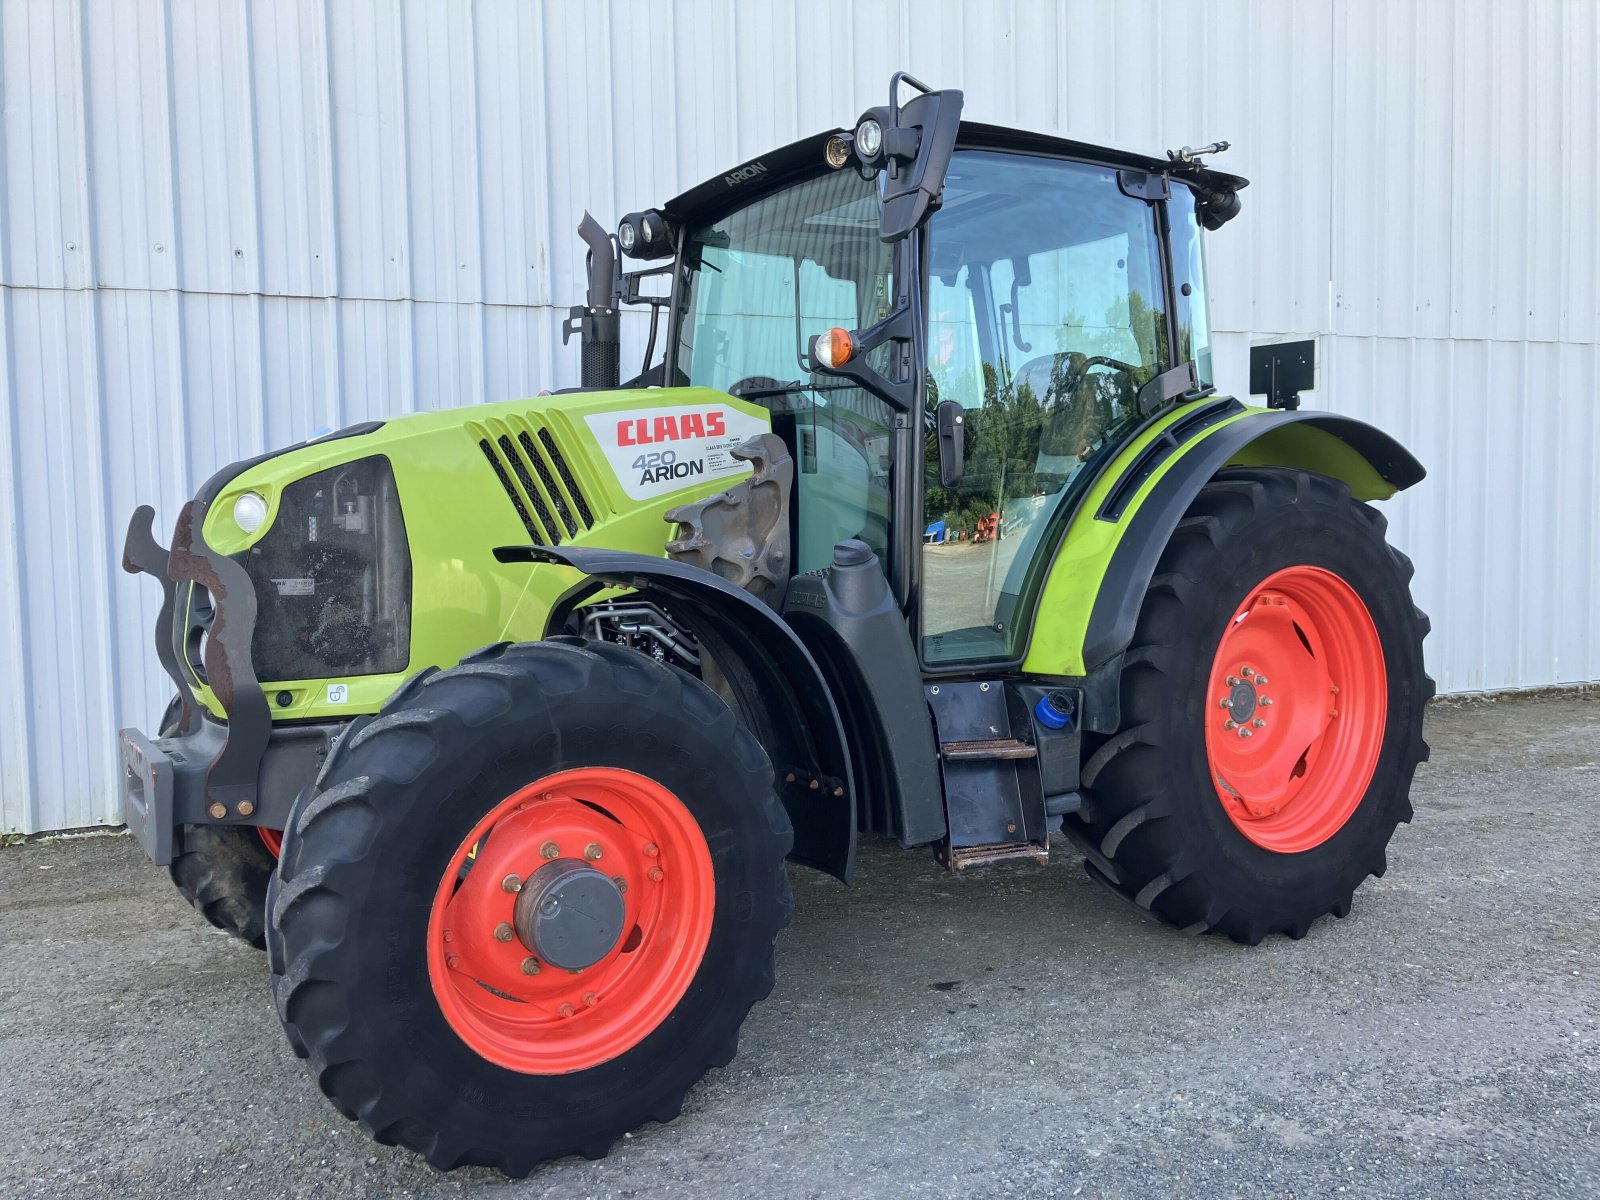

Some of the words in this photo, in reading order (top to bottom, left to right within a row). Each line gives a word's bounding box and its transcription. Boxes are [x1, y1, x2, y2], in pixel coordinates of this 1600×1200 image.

[725, 162, 768, 187] ARION
[617, 412, 726, 447] CLAAS
[632, 450, 676, 470] 420
[640, 459, 704, 486] ARION
